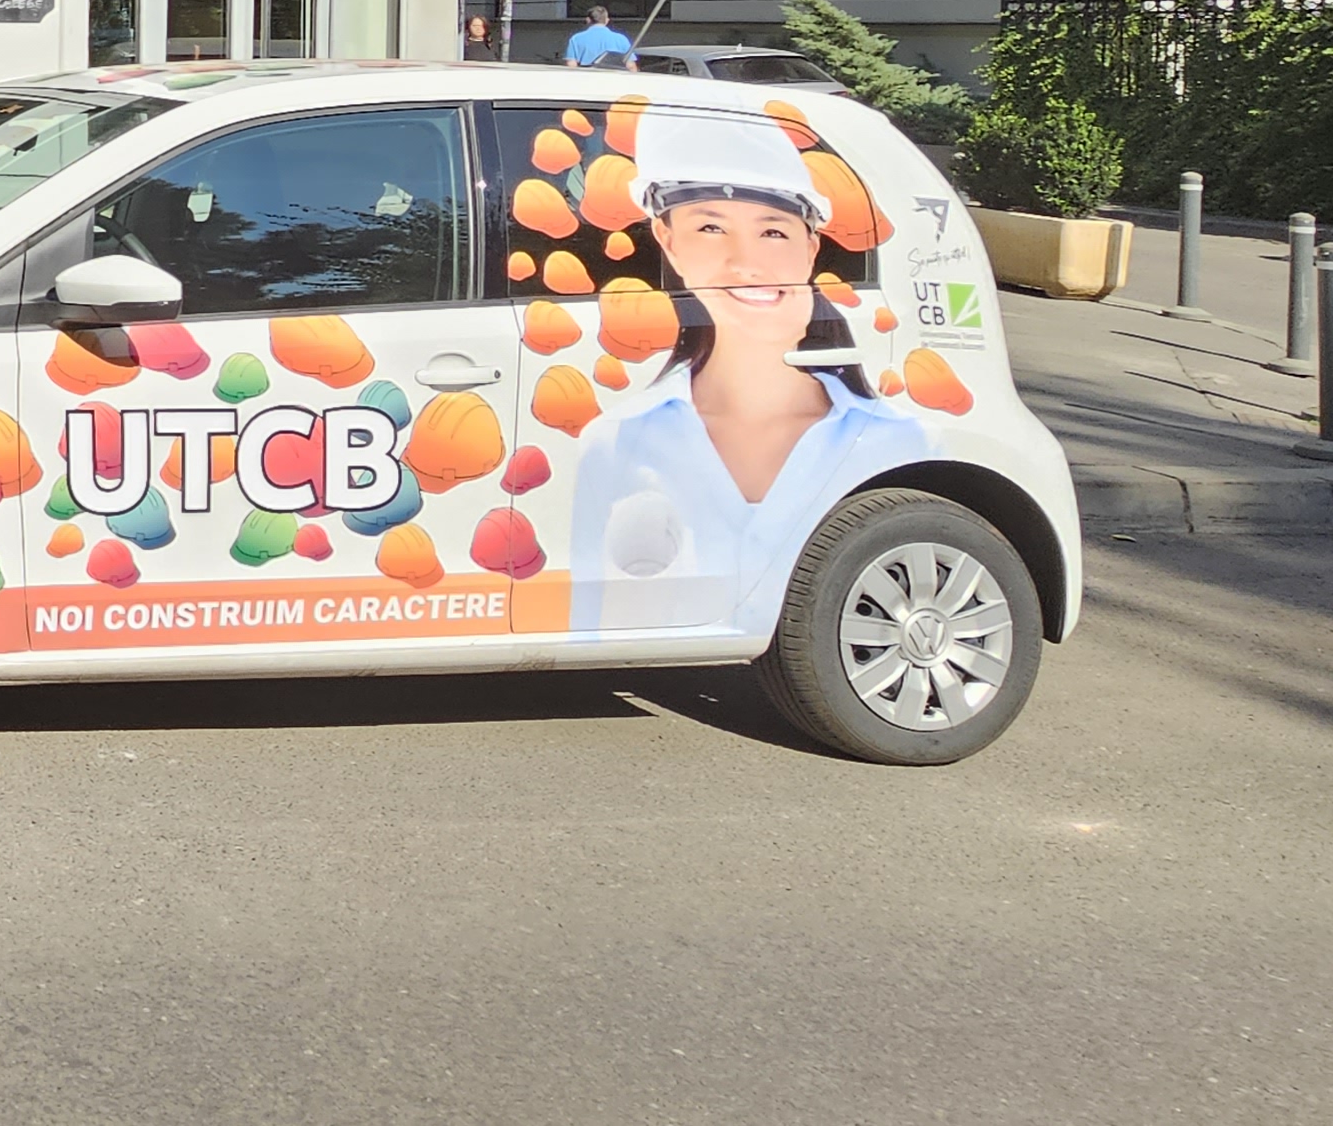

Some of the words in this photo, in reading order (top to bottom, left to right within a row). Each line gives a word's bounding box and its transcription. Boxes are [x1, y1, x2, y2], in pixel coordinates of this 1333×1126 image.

[913, 281, 941, 302] UT
[918, 304, 946, 325] CB
[65, 404, 403, 516] UTCB
[34, 605, 93, 632] NOI
[102, 596, 305, 631] CONSTRUIM
[312, 591, 508, 624] CARACTERE
